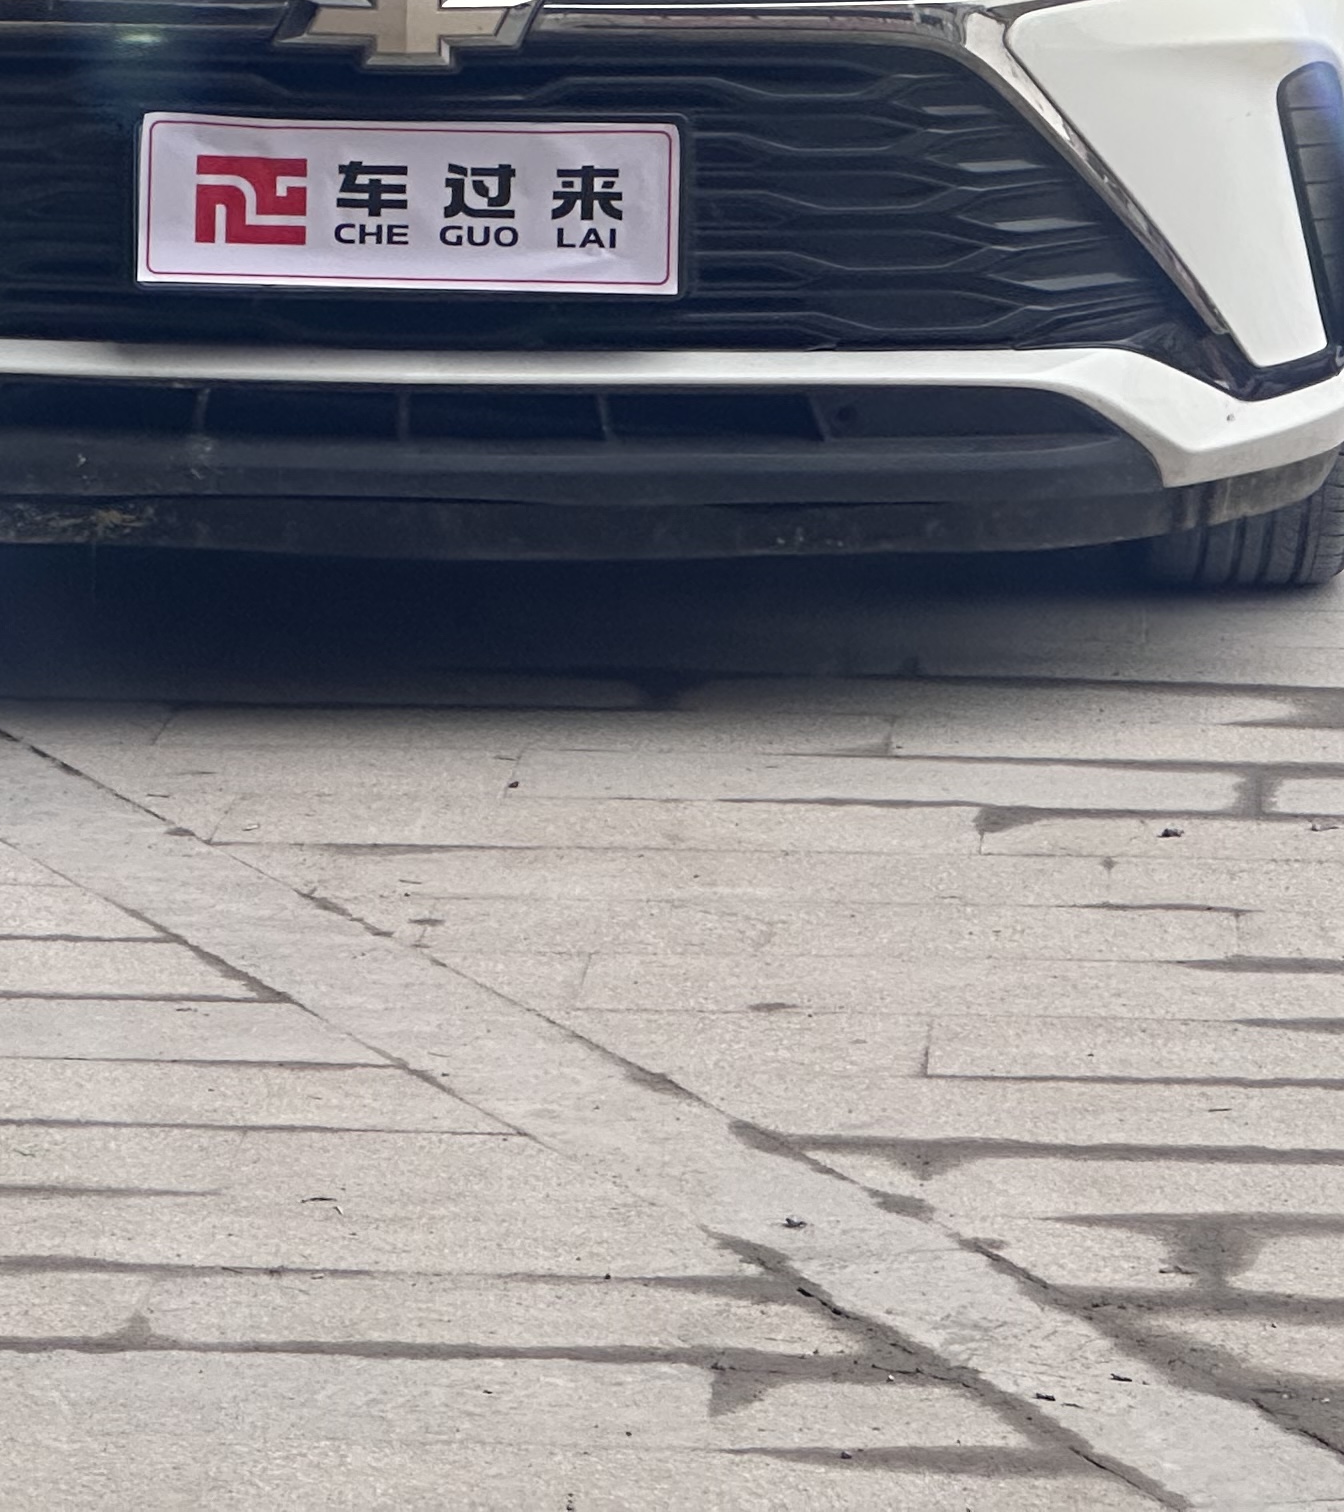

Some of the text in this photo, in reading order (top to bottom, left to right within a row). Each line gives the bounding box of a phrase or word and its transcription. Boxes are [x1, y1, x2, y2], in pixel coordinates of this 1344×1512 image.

[336, 160, 624, 222] 车过来
[333, 223, 617, 250] CHE GUO LAI
